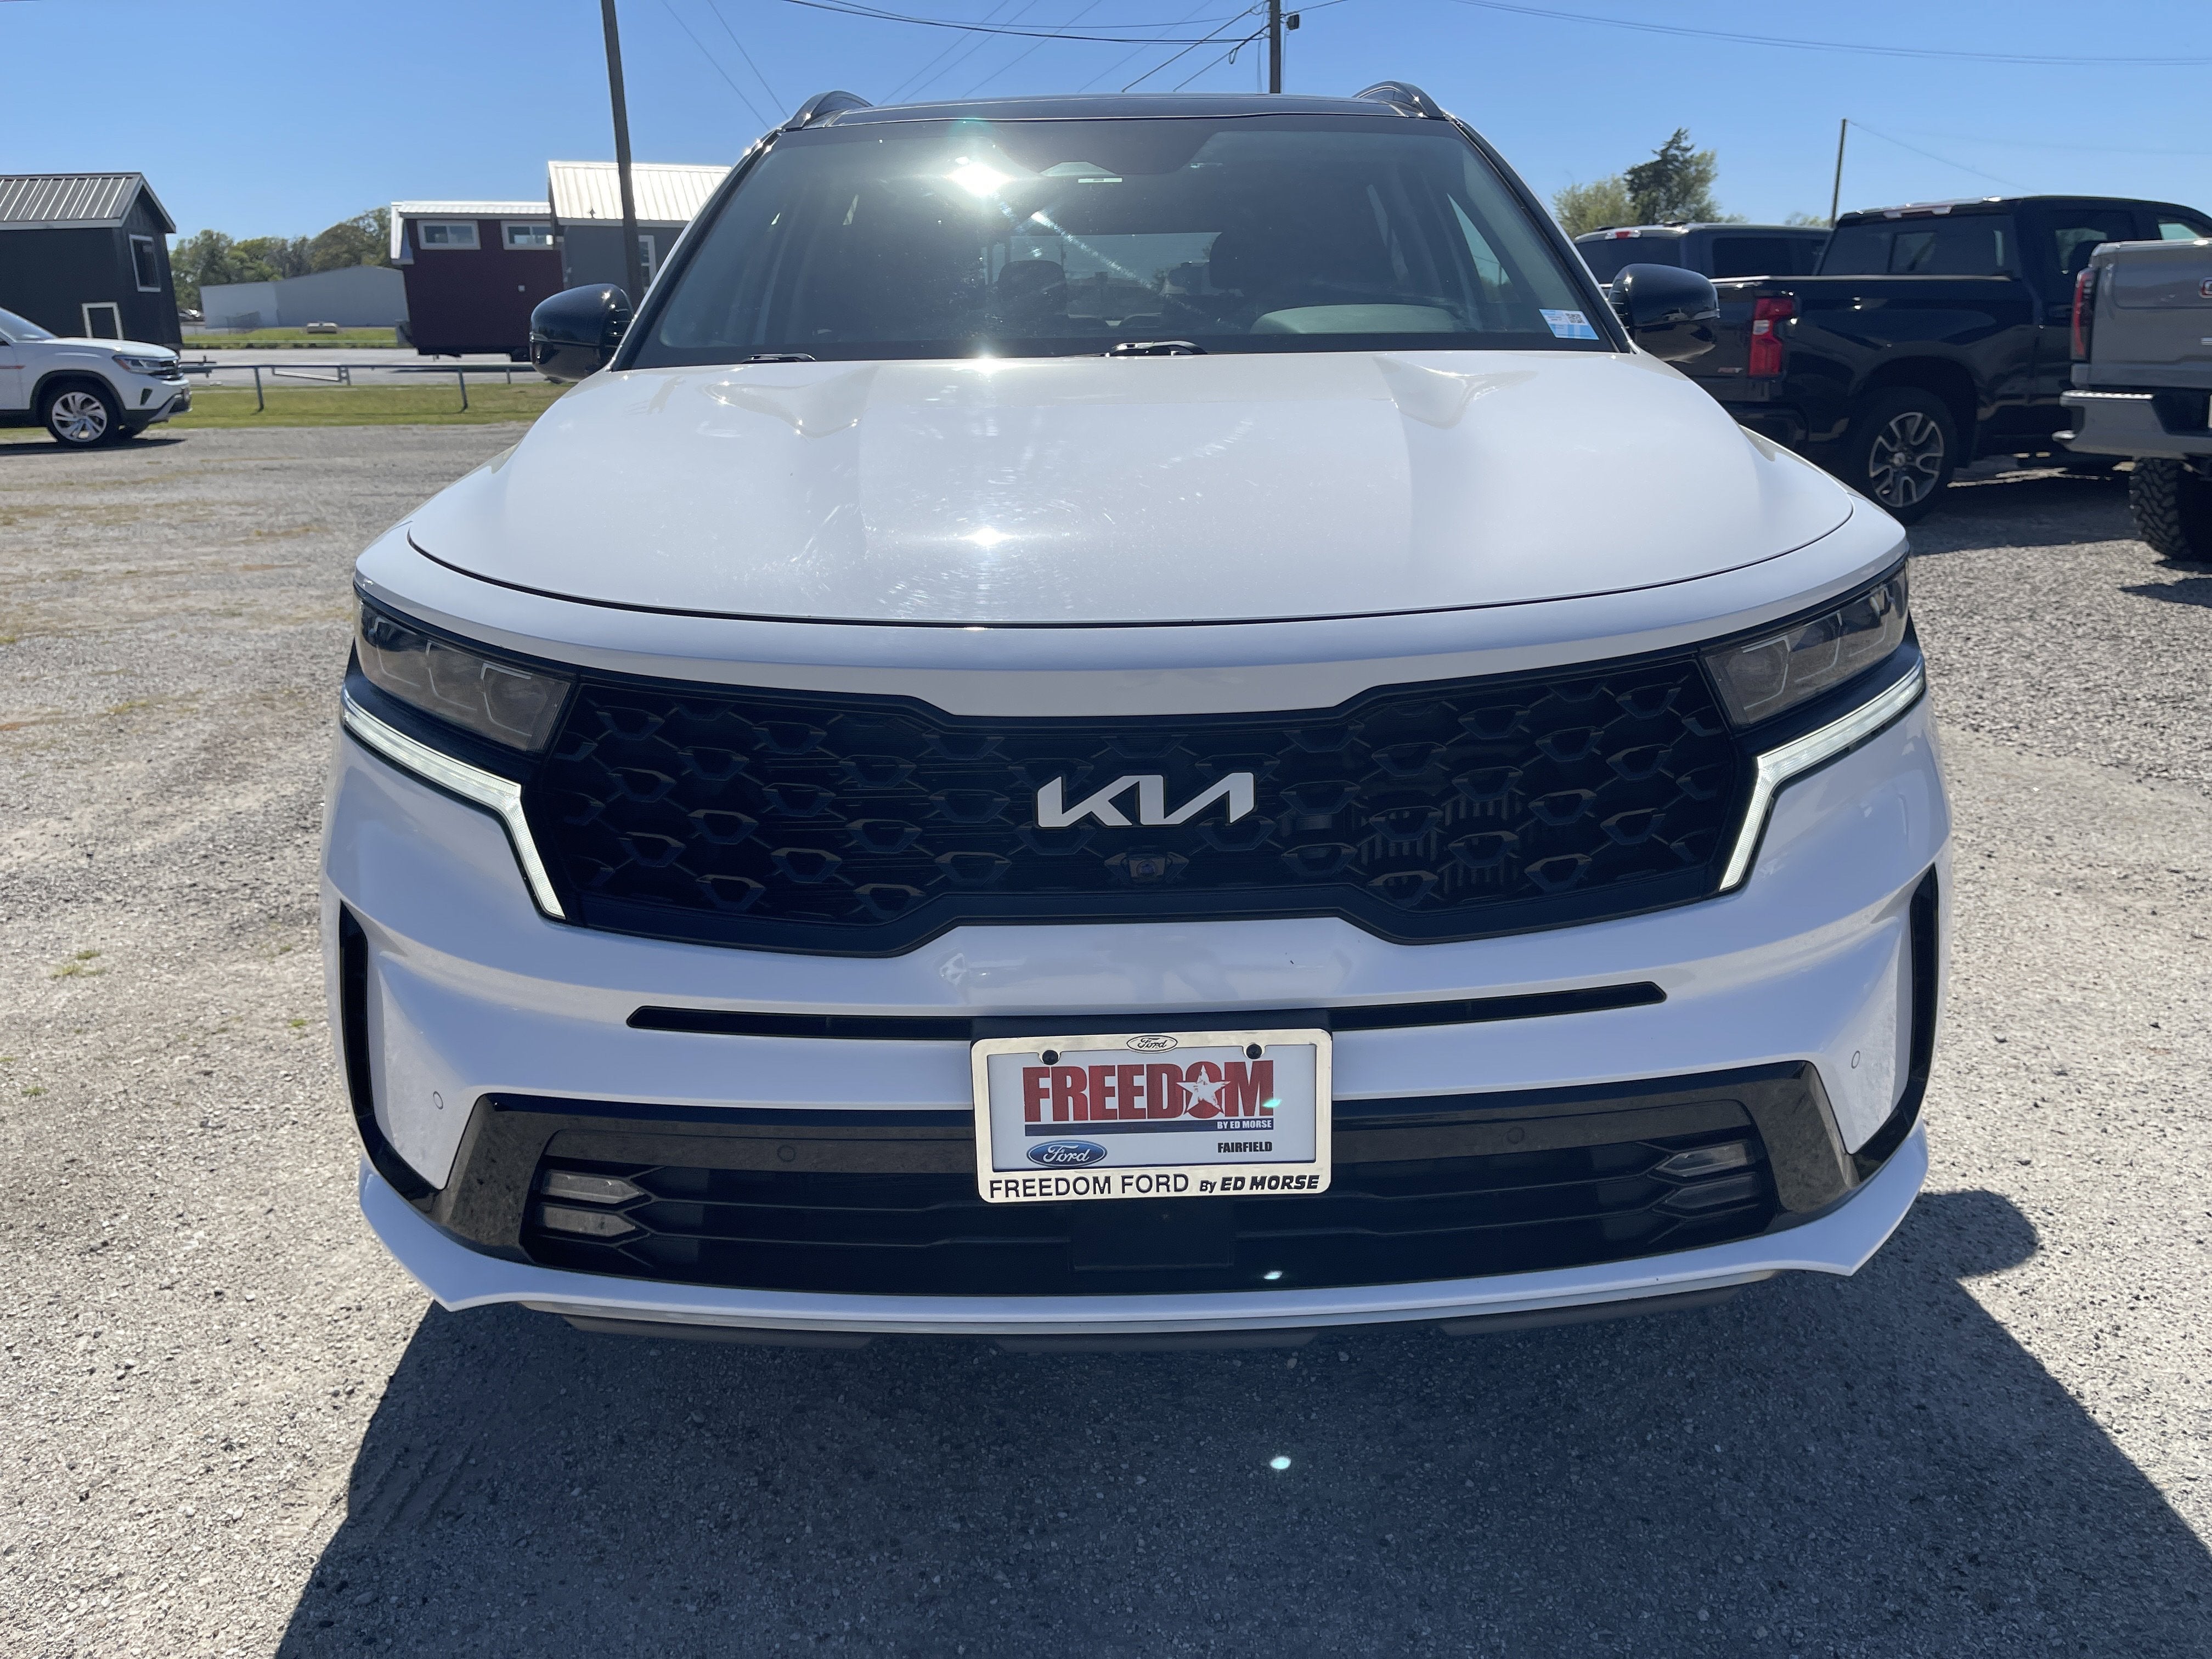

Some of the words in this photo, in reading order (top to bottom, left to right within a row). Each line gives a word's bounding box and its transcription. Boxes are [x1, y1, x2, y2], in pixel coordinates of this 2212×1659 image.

[1037, 772, 1255, 827] KIA
[1137, 1037, 1168, 1048] Ford
[1022, 1060, 1274, 1122] FREEDOM
[1217, 1121, 1228, 1129] BY
[1230, 1120, 1240, 1128] ED
[1242, 1120, 1272, 1128] MORSE
[1043, 1144, 1091, 1163] Ford
[1217, 1141, 1272, 1153] FAIRFIELD
[990, 1176, 1111, 1198] FREEDOM
[1121, 1173, 1189, 1193] FORD
[1220, 1176, 1246, 1191] ED
[1249, 1175, 1320, 1190] MORSE
